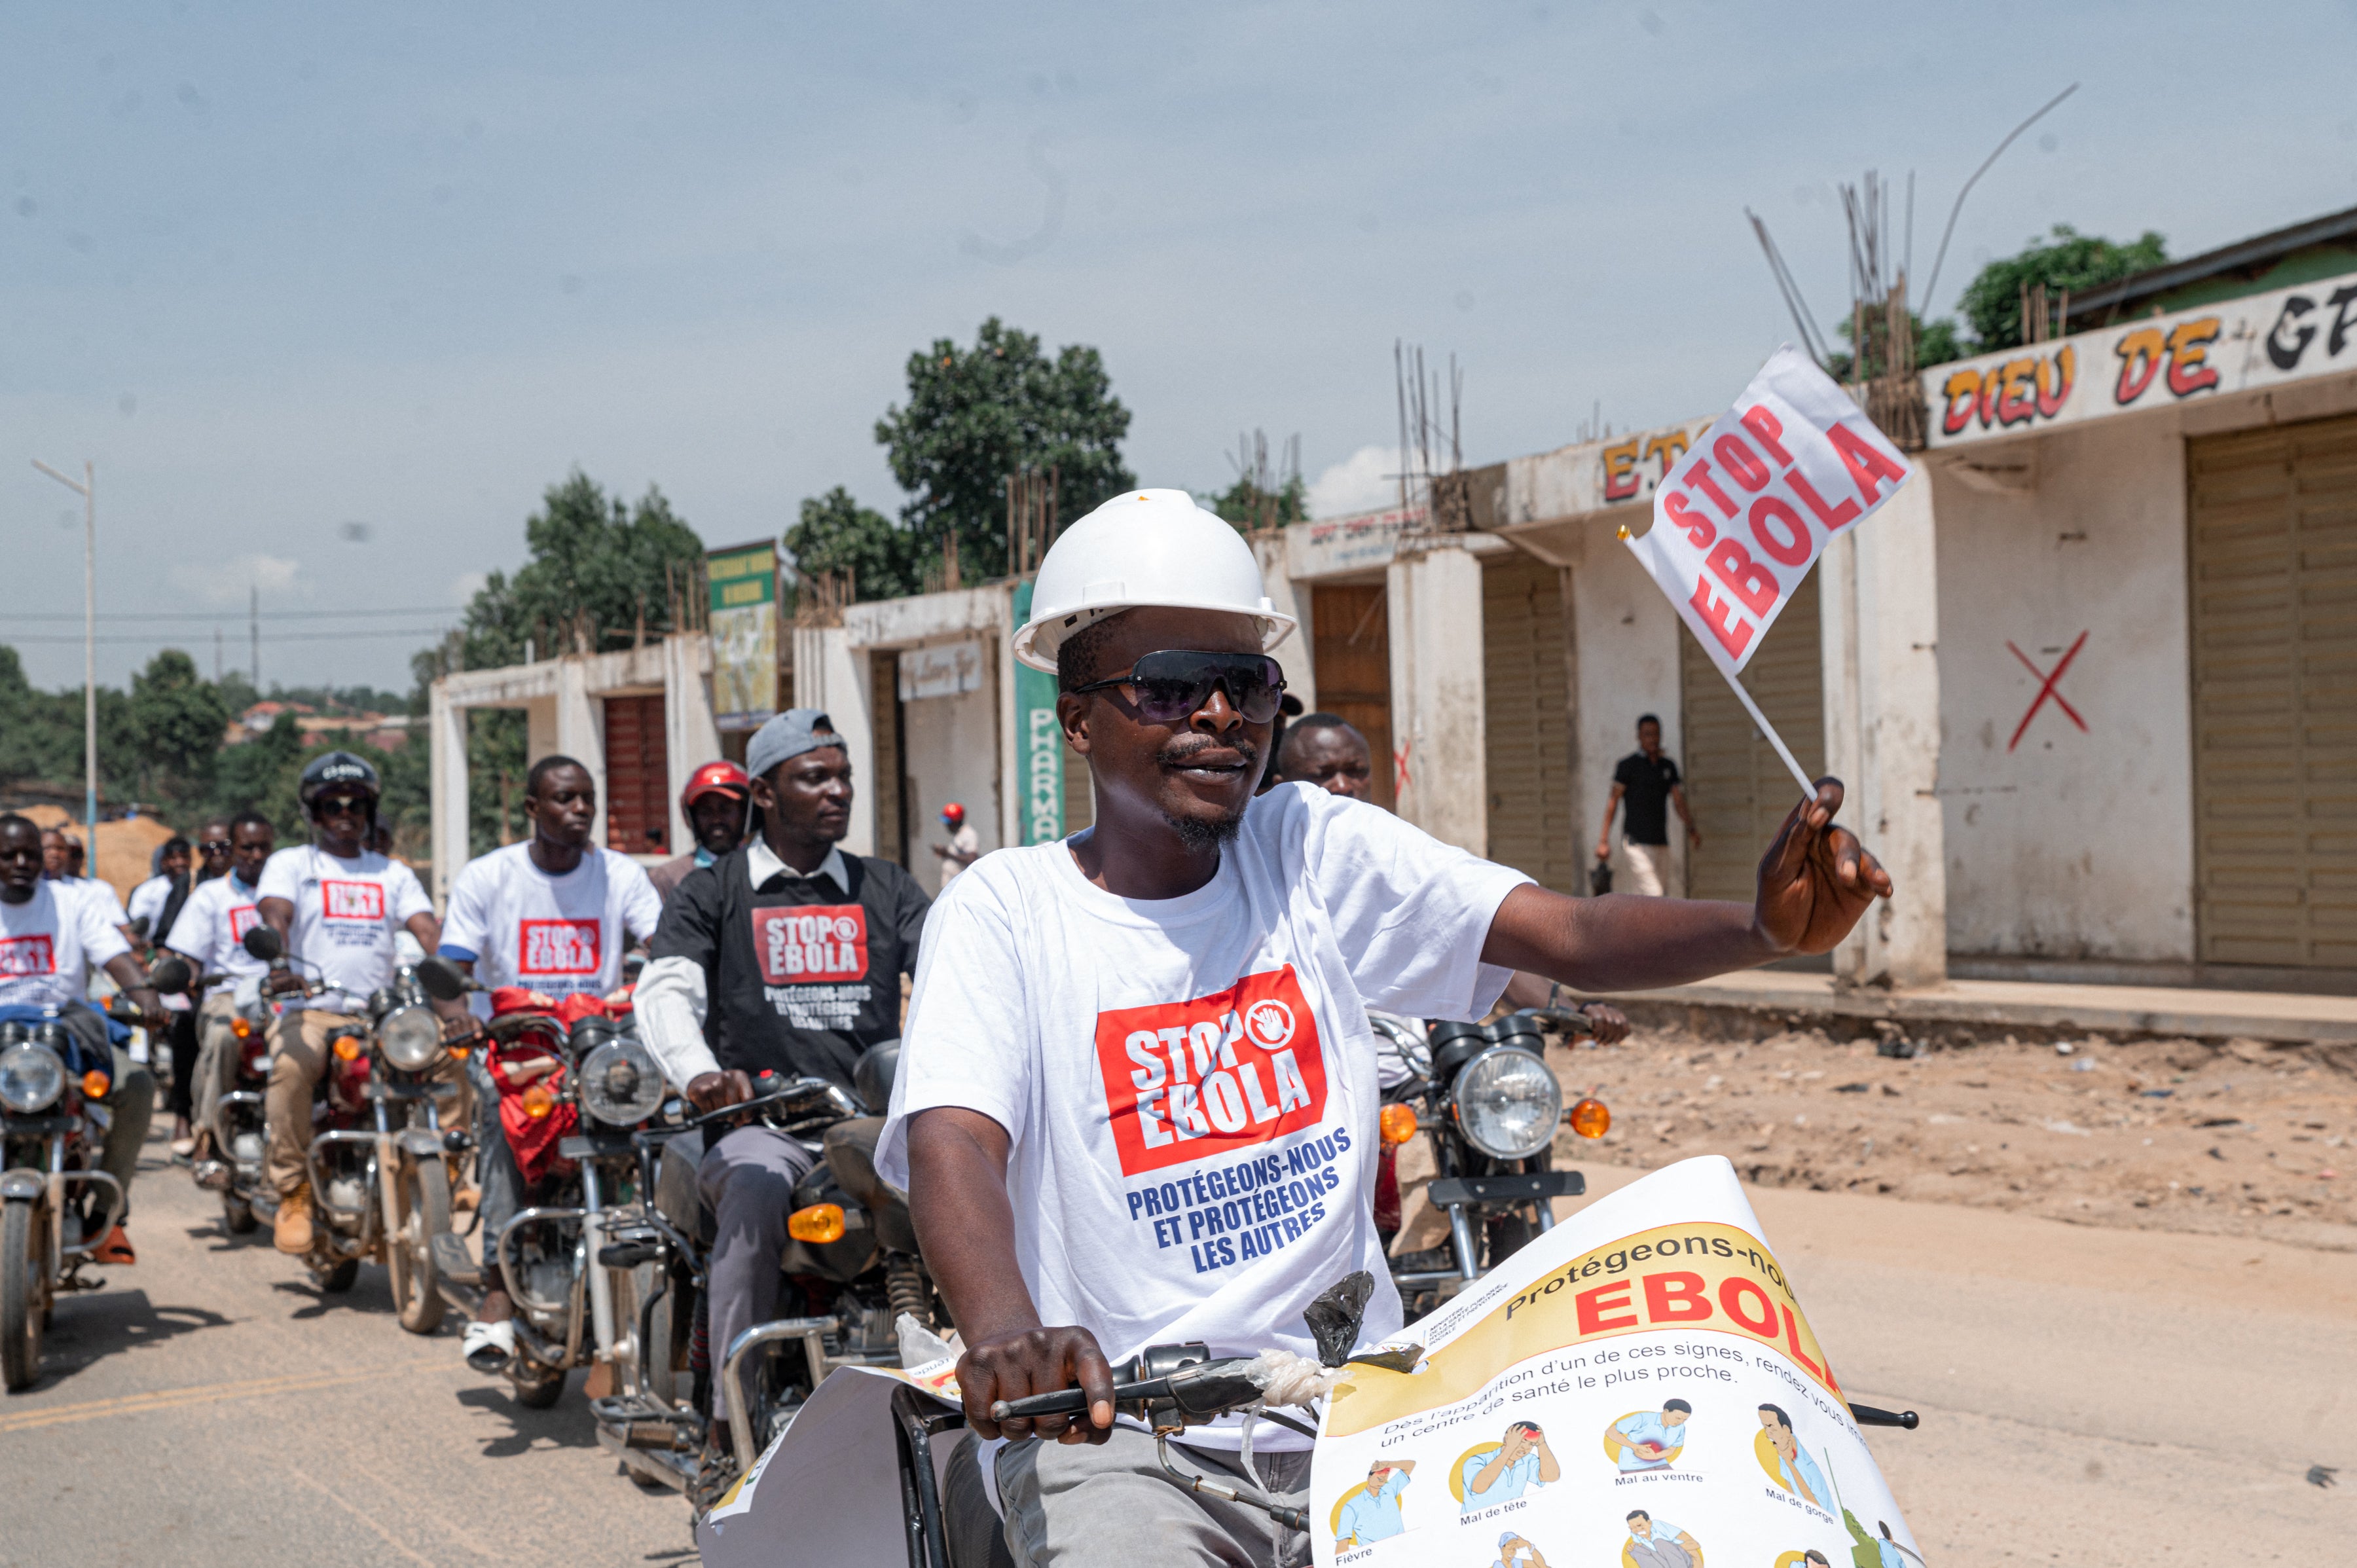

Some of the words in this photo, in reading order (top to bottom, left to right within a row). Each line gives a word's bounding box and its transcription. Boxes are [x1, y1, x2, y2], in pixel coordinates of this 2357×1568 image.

[1943, 344, 2076, 435] DIEU
[2115, 317, 2221, 405] DE
[1664, 404, 1795, 550] STOP
[1689, 421, 1907, 662] EBOLA
[1030, 708, 1059, 845] PHARMA
[527, 925, 577, 948] STOP
[527, 945, 594, 970] EBOLA
[766, 915, 833, 945] STOP
[769, 941, 859, 975] EBOLA
[1125, 1009, 1244, 1090] STOP
[1136, 1048, 1311, 1150] EBOLA
[1126, 1127, 1351, 1221] PROTÉGEONS-NOUS
[1153, 1216, 1182, 1249] ET
[1188, 1166, 1340, 1240] PROTÉGEONS
[1190, 1237, 1236, 1274] LES
[1240, 1202, 1326, 1262] AUTRES
[1429, 1326, 1456, 1347] SOCIALE
[1381, 1434, 1404, 1448] un
[1412, 1413, 1474, 1438] centre
[1482, 1396, 1504, 1415] de
[1511, 1377, 1571, 1402] santé
[1579, 1376, 1596, 1389] le
[1605, 1366, 1649, 1388] plus
[1657, 1364, 1738, 1383] proche.
[1385, 1417, 1423, 1435] Dès
[1431, 1369, 1534, 1420] l'apparition
[1541, 1356, 1586, 1376] d'un
[1594, 1350, 1620, 1365] de
[1628, 1343, 1666, 1359] ces
[1674, 1341, 1749, 1368] signes,
[1756, 1357, 1809, 1399] rendez
[1811, 1392, 1845, 1426] vous
[1460, 1512, 1482, 1526] Mal
[1485, 1507, 1501, 1519] de
[1504, 1499, 1527, 1514] tête
[1615, 1474, 1637, 1486] Mal
[1661, 1472, 1704, 1482] ventre
[1765, 1487, 1785, 1503] Mal
[1789, 1497, 1802, 1508] de
[1805, 1504, 1835, 1525] gorge
[1335, 1547, 1373, 1567] Fièvre
